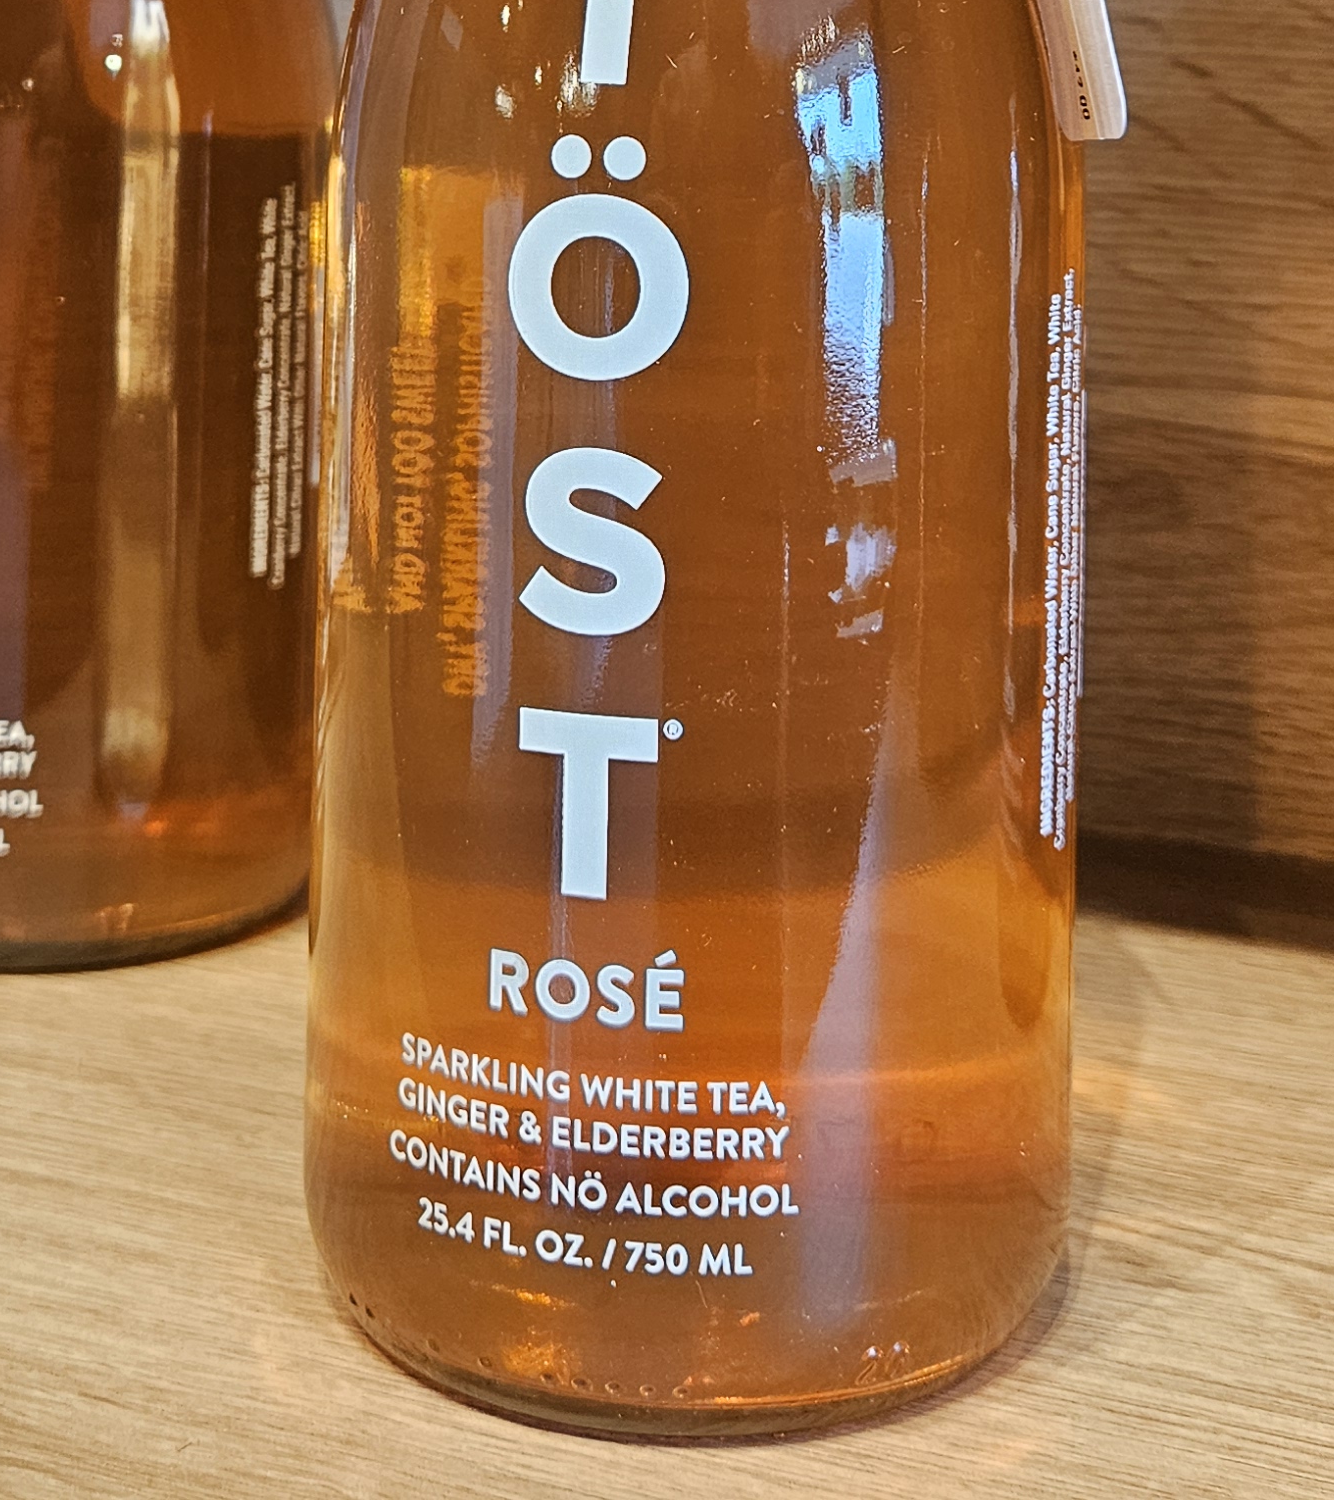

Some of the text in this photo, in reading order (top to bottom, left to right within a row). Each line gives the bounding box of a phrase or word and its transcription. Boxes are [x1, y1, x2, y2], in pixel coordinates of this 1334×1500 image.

[1046, 294, 1061, 345] White
[1046, 346, 1061, 382] Tea,
[1045, 385, 1060, 436] White
[1045, 437, 1061, 492] Sugar,
[1045, 495, 1059, 539] Cane
[1044, 541, 1060, 598] Water,
[1042, 600, 1058, 698] Carbonated
[489, 948, 685, 1032] ROSÉ
[401, 1032, 786, 1118] SPARKLING WHITE TEA,
[398, 1077, 790, 1161] GINGER & ELDERBERRY
[389, 1130, 800, 1217] CONTAINS NÖ ALCOHOL
[417, 1197, 753, 1276] 25.4 FL. OZ. / 750 ML
